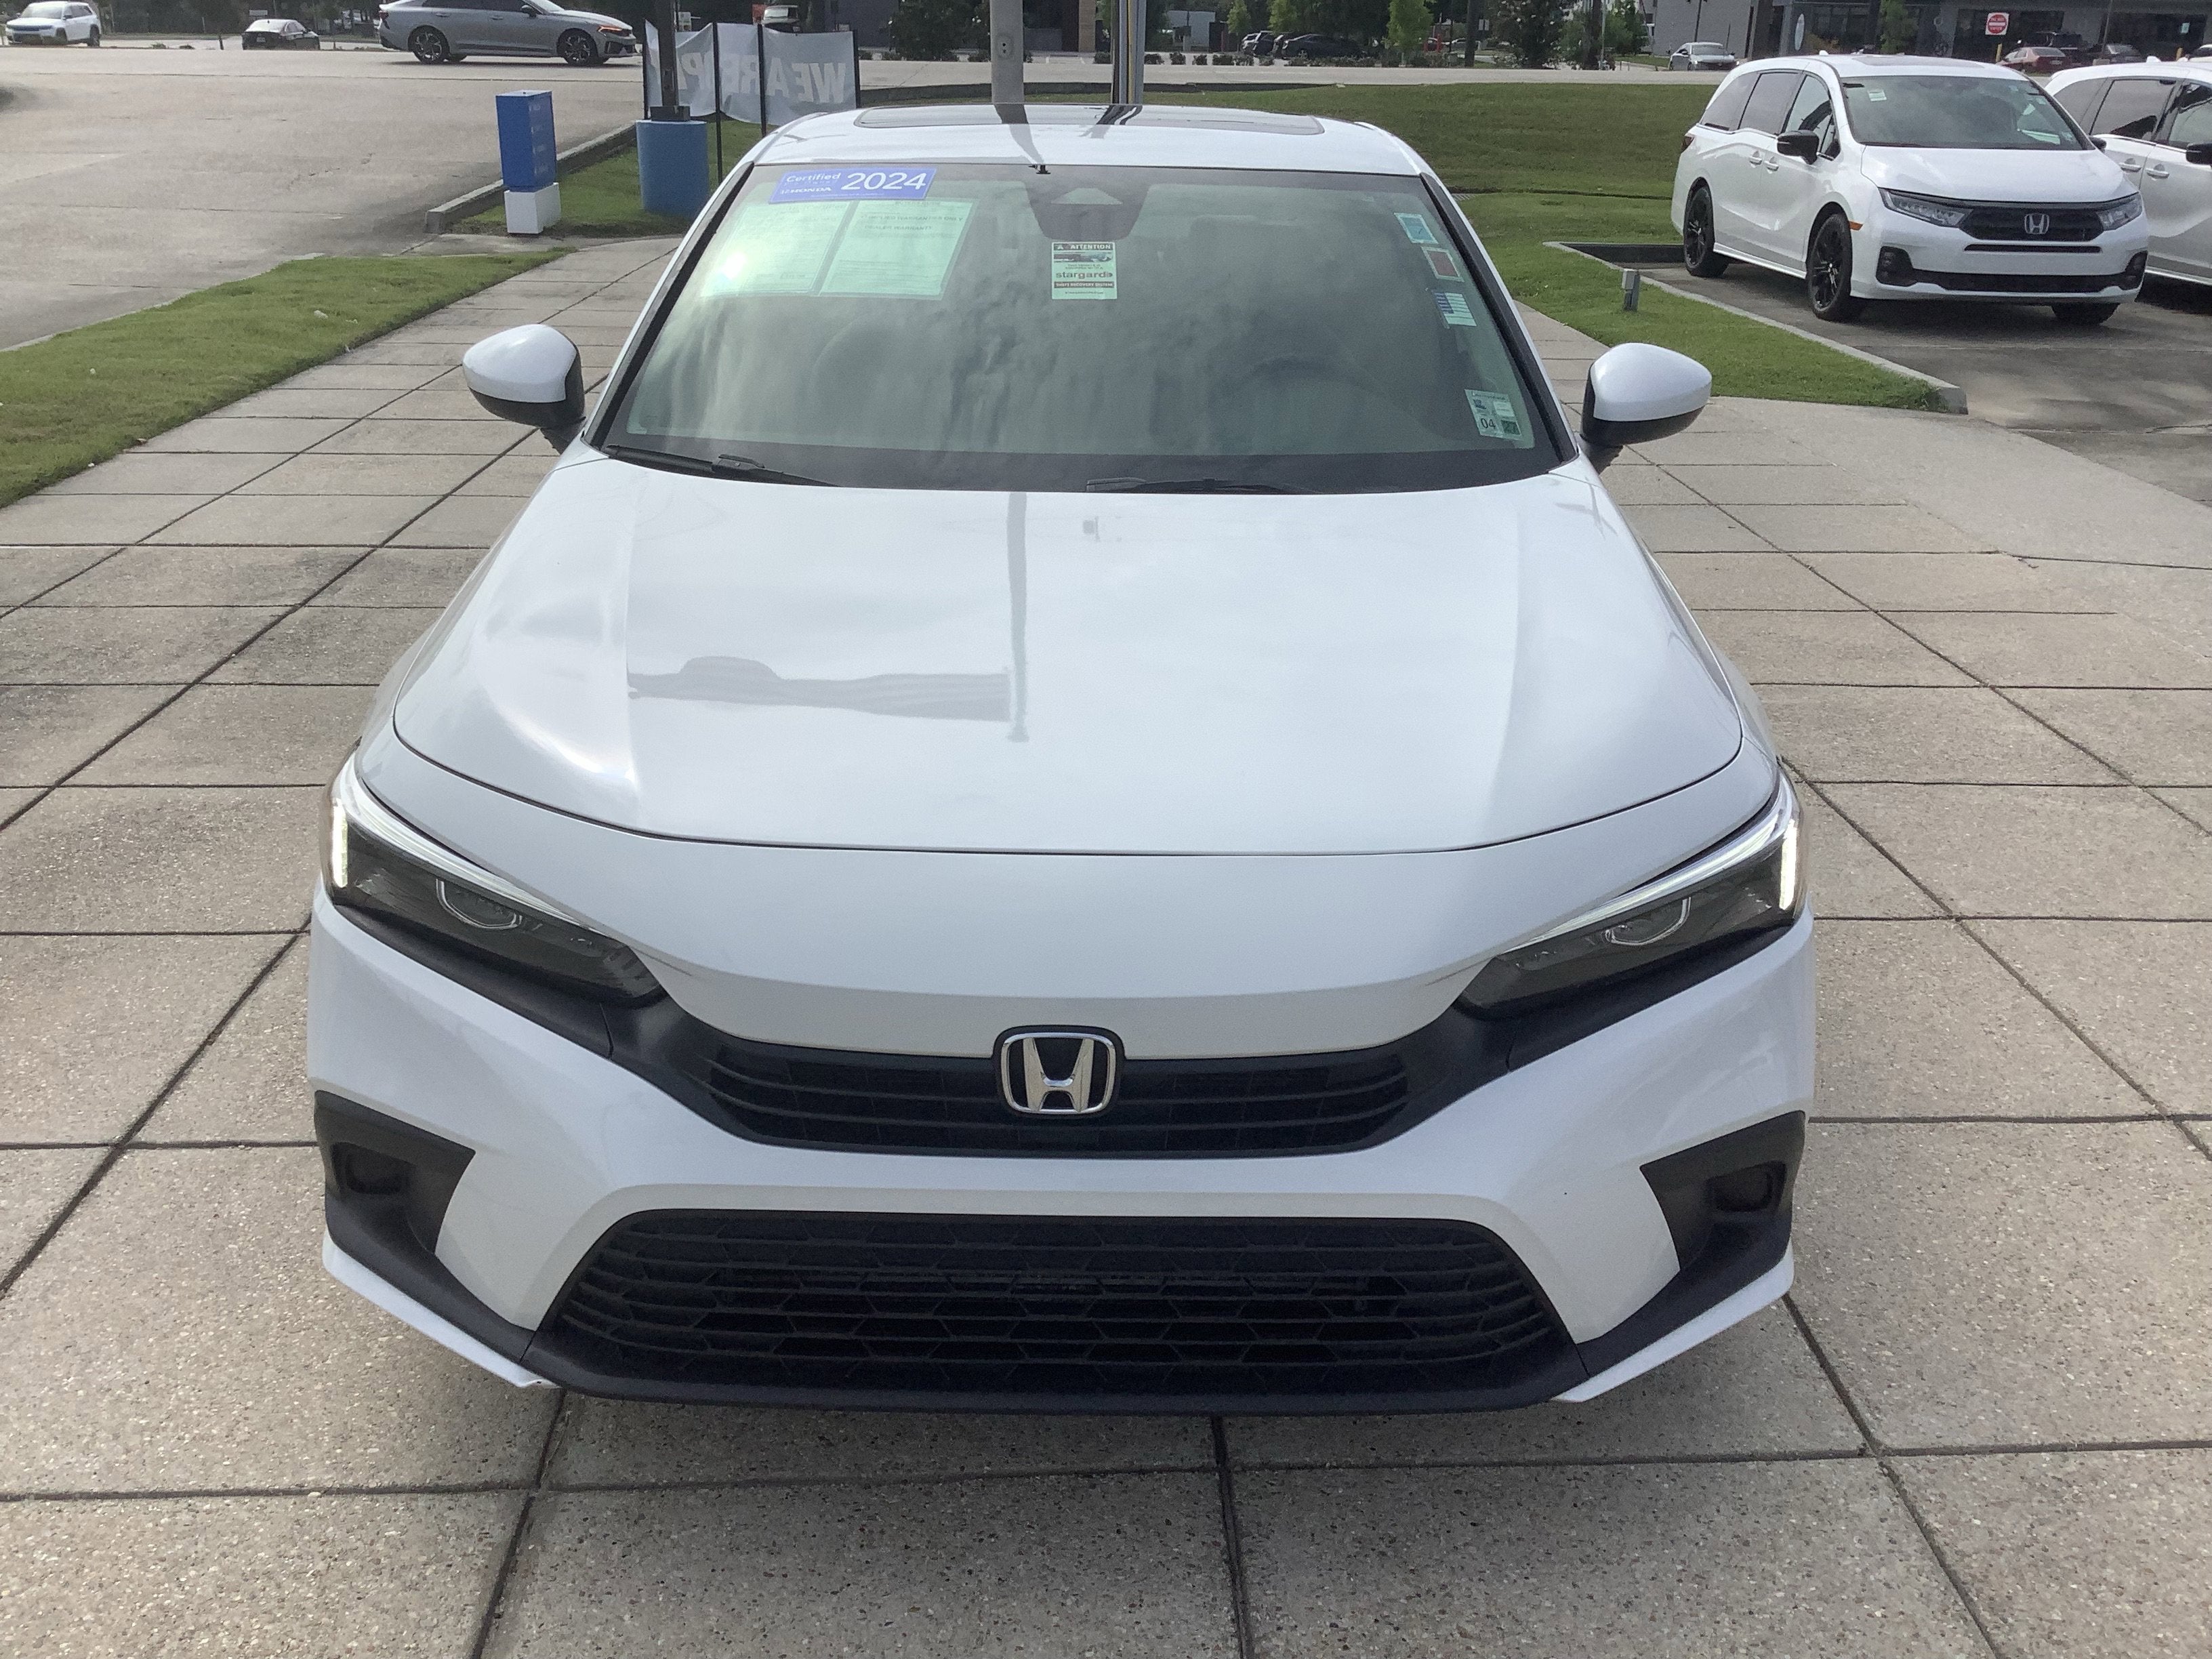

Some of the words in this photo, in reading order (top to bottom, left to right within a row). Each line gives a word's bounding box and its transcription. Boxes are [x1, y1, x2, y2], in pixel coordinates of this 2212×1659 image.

[787, 173, 841, 182] Certified
[840, 172, 927, 190] 2024
[1481, 418, 1496, 429] 04
